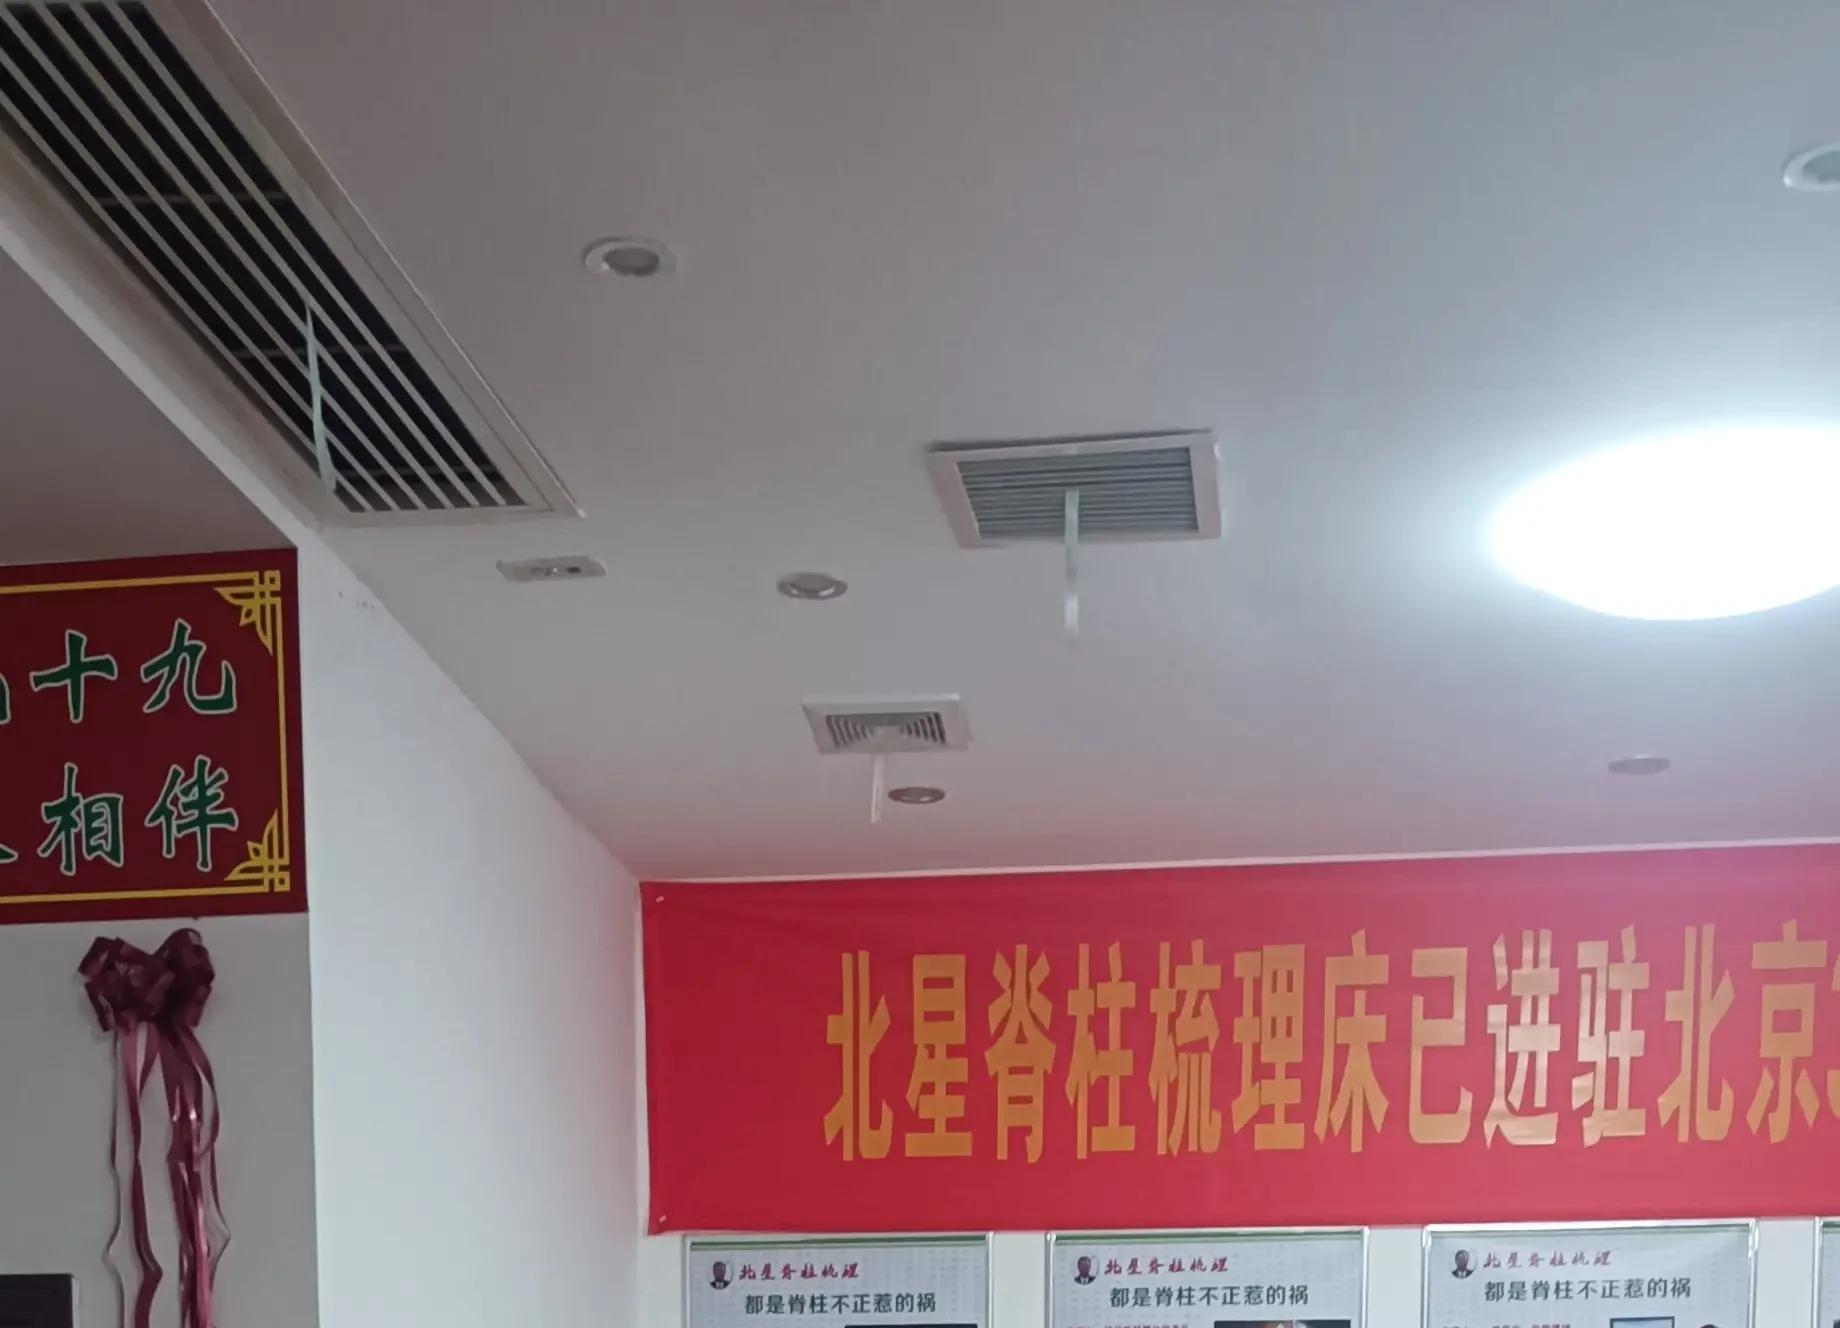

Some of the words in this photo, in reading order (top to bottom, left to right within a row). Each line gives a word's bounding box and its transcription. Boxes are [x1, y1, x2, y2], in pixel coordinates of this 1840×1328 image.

[0, 618, 238, 724] 十九
[0, 755, 239, 876] 相伴
[822, 918, 1840, 1163] 北星脊柱梳理床已进驻北京
[745, 1292, 937, 1315] 都是脊柱不正惹的祸
[1110, 1284, 1310, 1309] 都是脊柱不正惹的祸
[1484, 1277, 1692, 1303] 都是脊柱不正惹的祸
